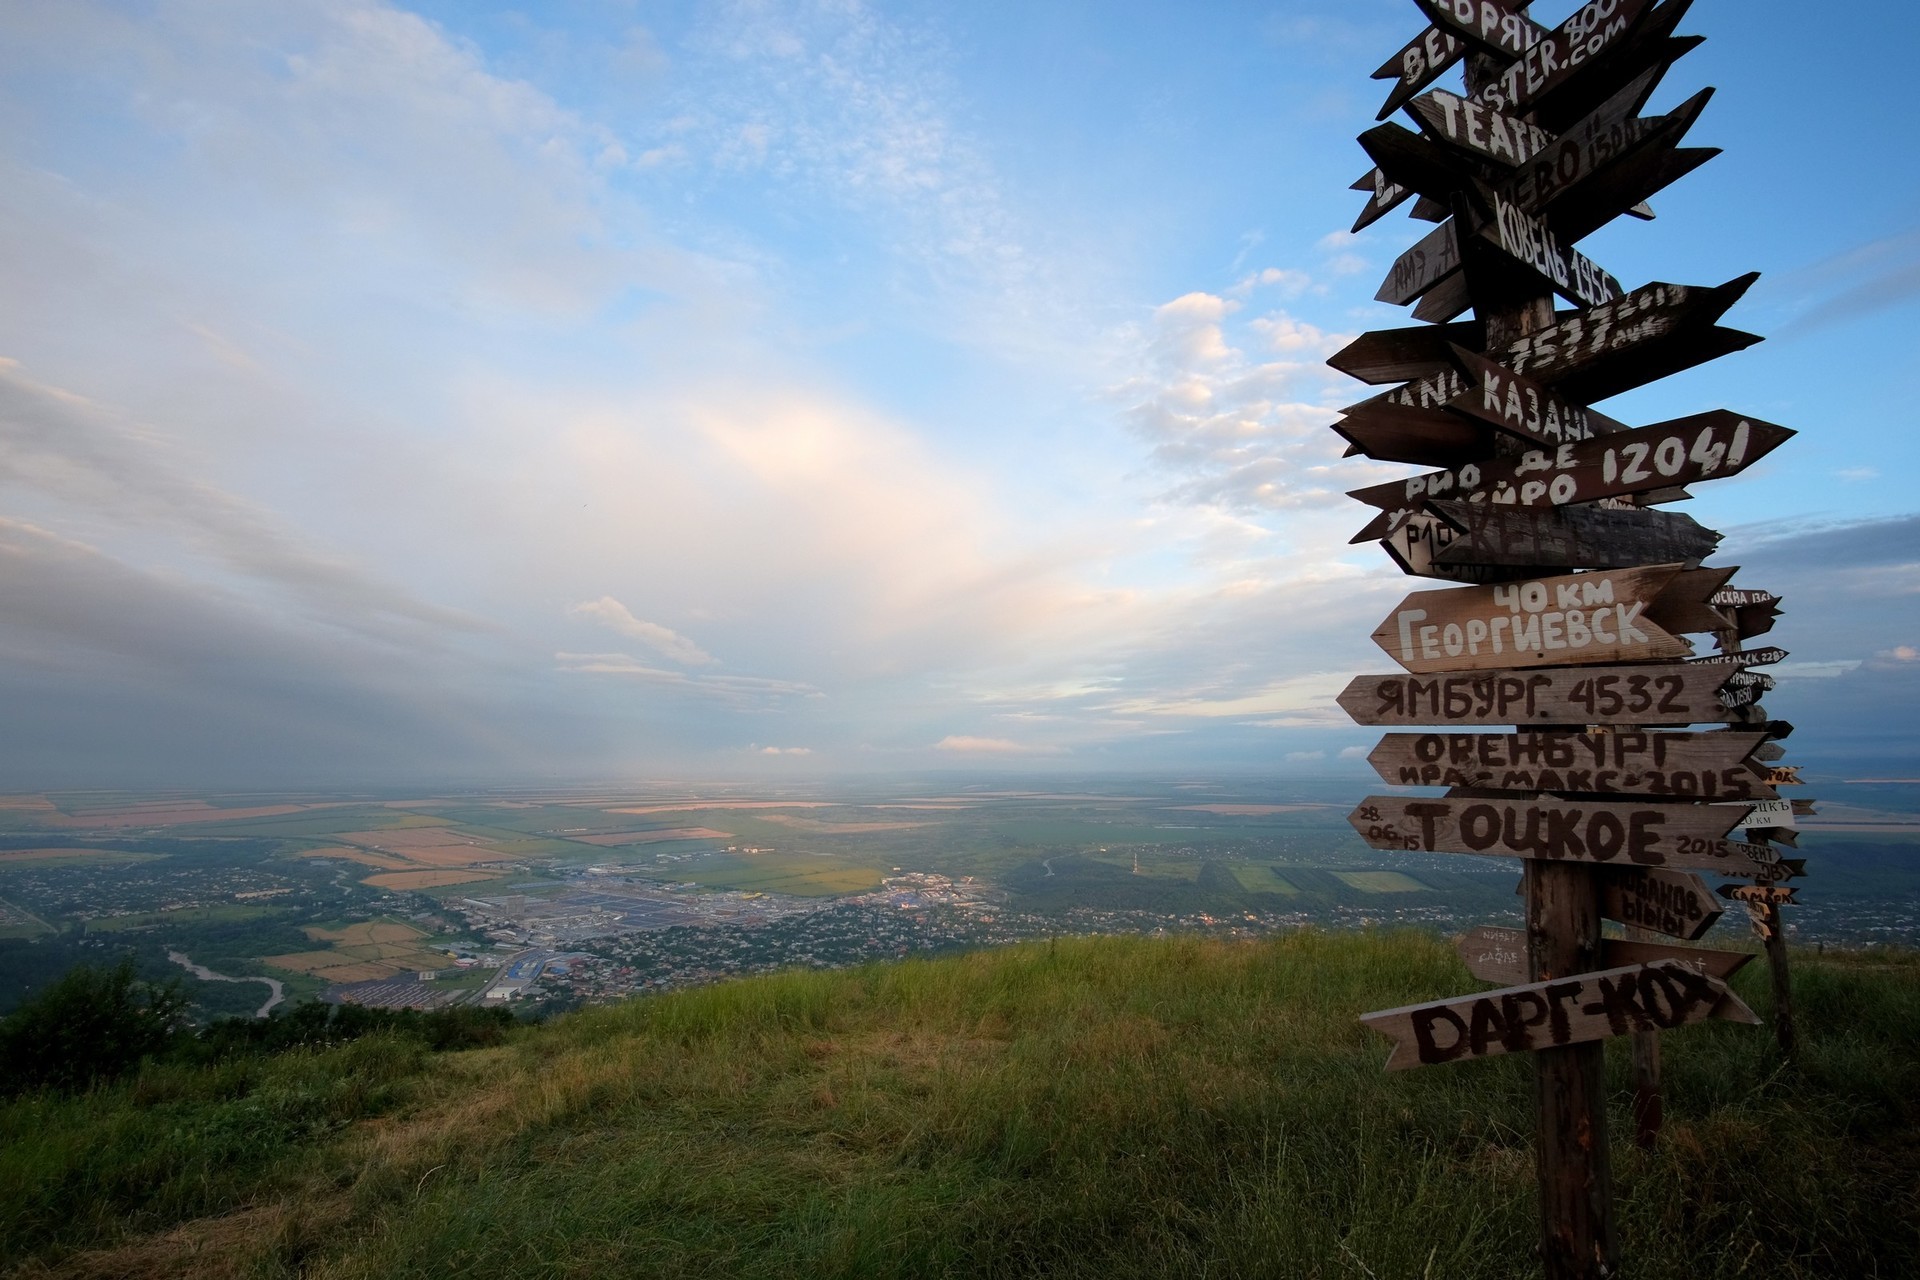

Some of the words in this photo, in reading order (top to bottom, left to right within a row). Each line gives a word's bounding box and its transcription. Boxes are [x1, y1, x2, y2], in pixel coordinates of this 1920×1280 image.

[1493, 190, 1569, 289] КОВЕЛЬ
[1405, 463, 1481, 502] РИО
[1514, 443, 1580, 478] ДЕ
[1603, 420, 1750, 485] 12041
[1493, 582, 1548, 614] 40
[1375, 674, 1553, 718] ЯМБУРГ
[1568, 674, 1690, 716] 4532
[1415, 733, 1694, 768] ОРЕНБУРГ
[1404, 802, 1667, 865] ТОЦКОЕ
[1676, 834, 1730, 858] 2015
[1731, 890, 1793, 904] САМАРА
